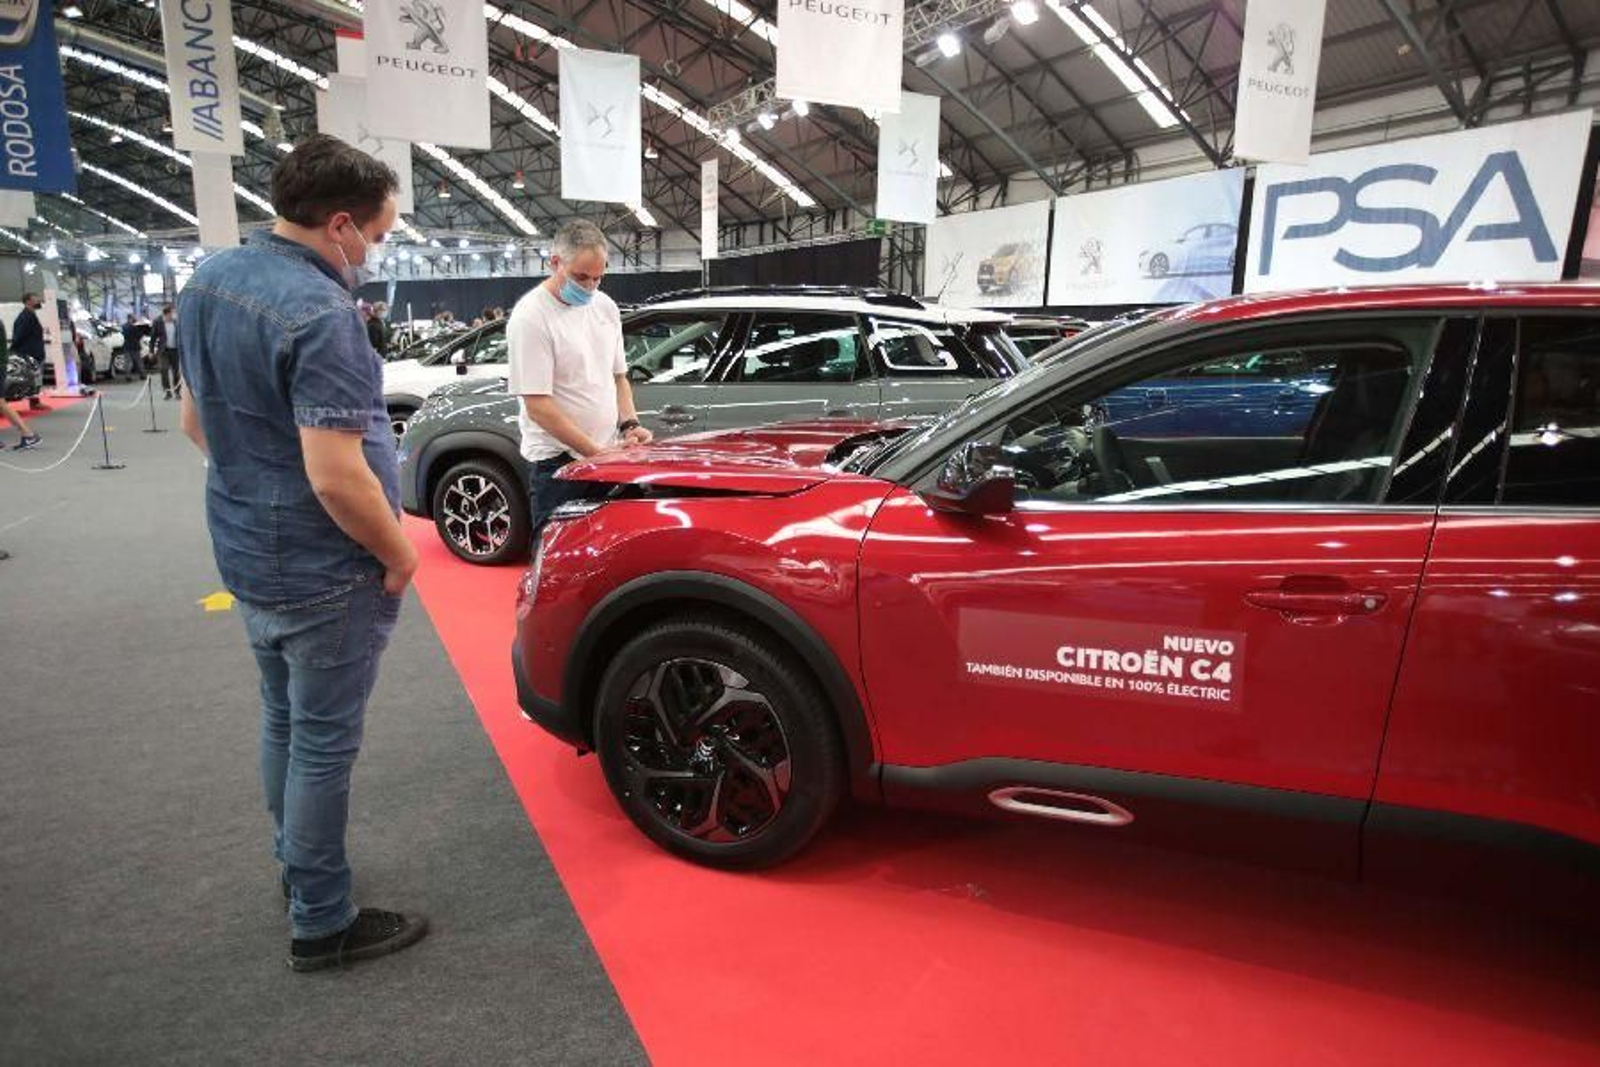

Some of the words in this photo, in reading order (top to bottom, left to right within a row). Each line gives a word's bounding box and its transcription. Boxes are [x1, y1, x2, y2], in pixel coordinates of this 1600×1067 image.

[377, 55, 478, 78] PEUGEOT
[1248, 77, 1309, 97] PEUGEOT
[0, 64, 38, 177] RODOSA
[1258, 150, 1559, 276] PSA
[1163, 635, 1234, 656] NUEVO
[966, 662, 1022, 678] TAMBIÉN
[1025, 668, 1102, 687] DISPONIBLE
[1104, 677, 1124, 689] EN
[1128, 680, 1164, 694] 100%
[1056, 646, 1183, 678] CITROËN
[1190, 659, 1232, 683] C4
